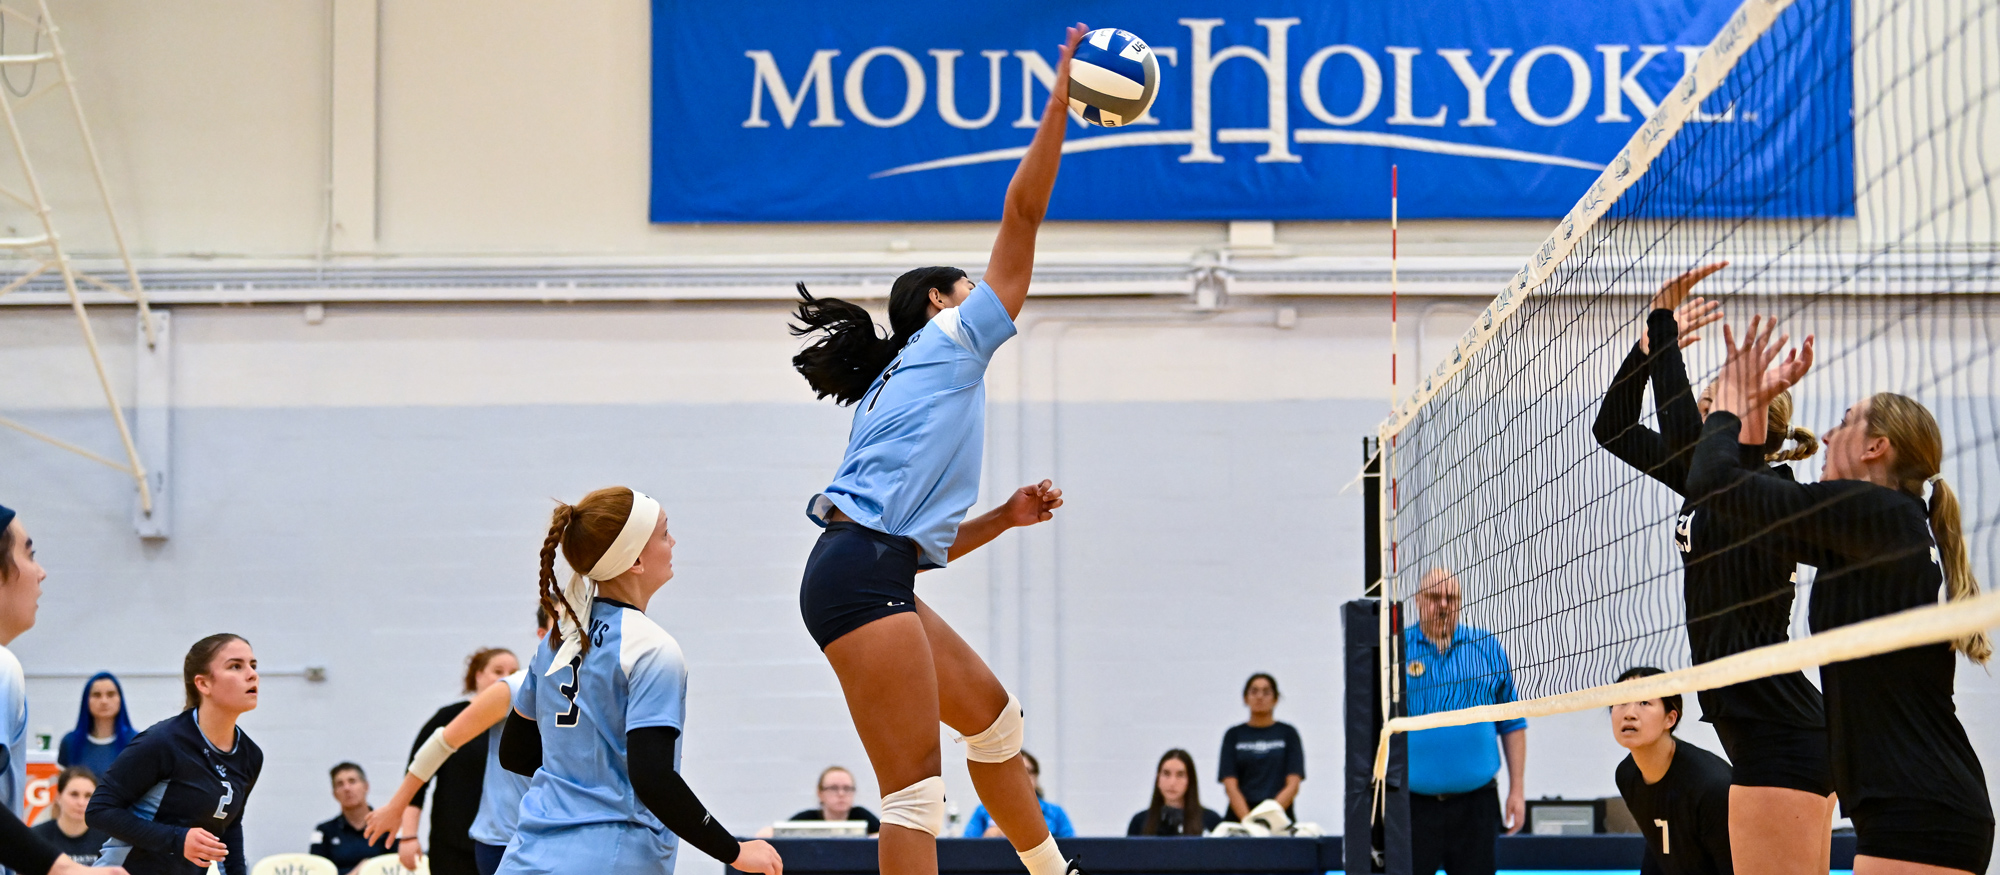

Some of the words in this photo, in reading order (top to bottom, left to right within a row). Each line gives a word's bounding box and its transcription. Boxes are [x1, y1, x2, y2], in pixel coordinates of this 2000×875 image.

[741, 46, 1178, 130] MOUN
[555, 654, 582, 727] 3
[25, 780, 51, 807] G
[213, 780, 234, 820] 2
